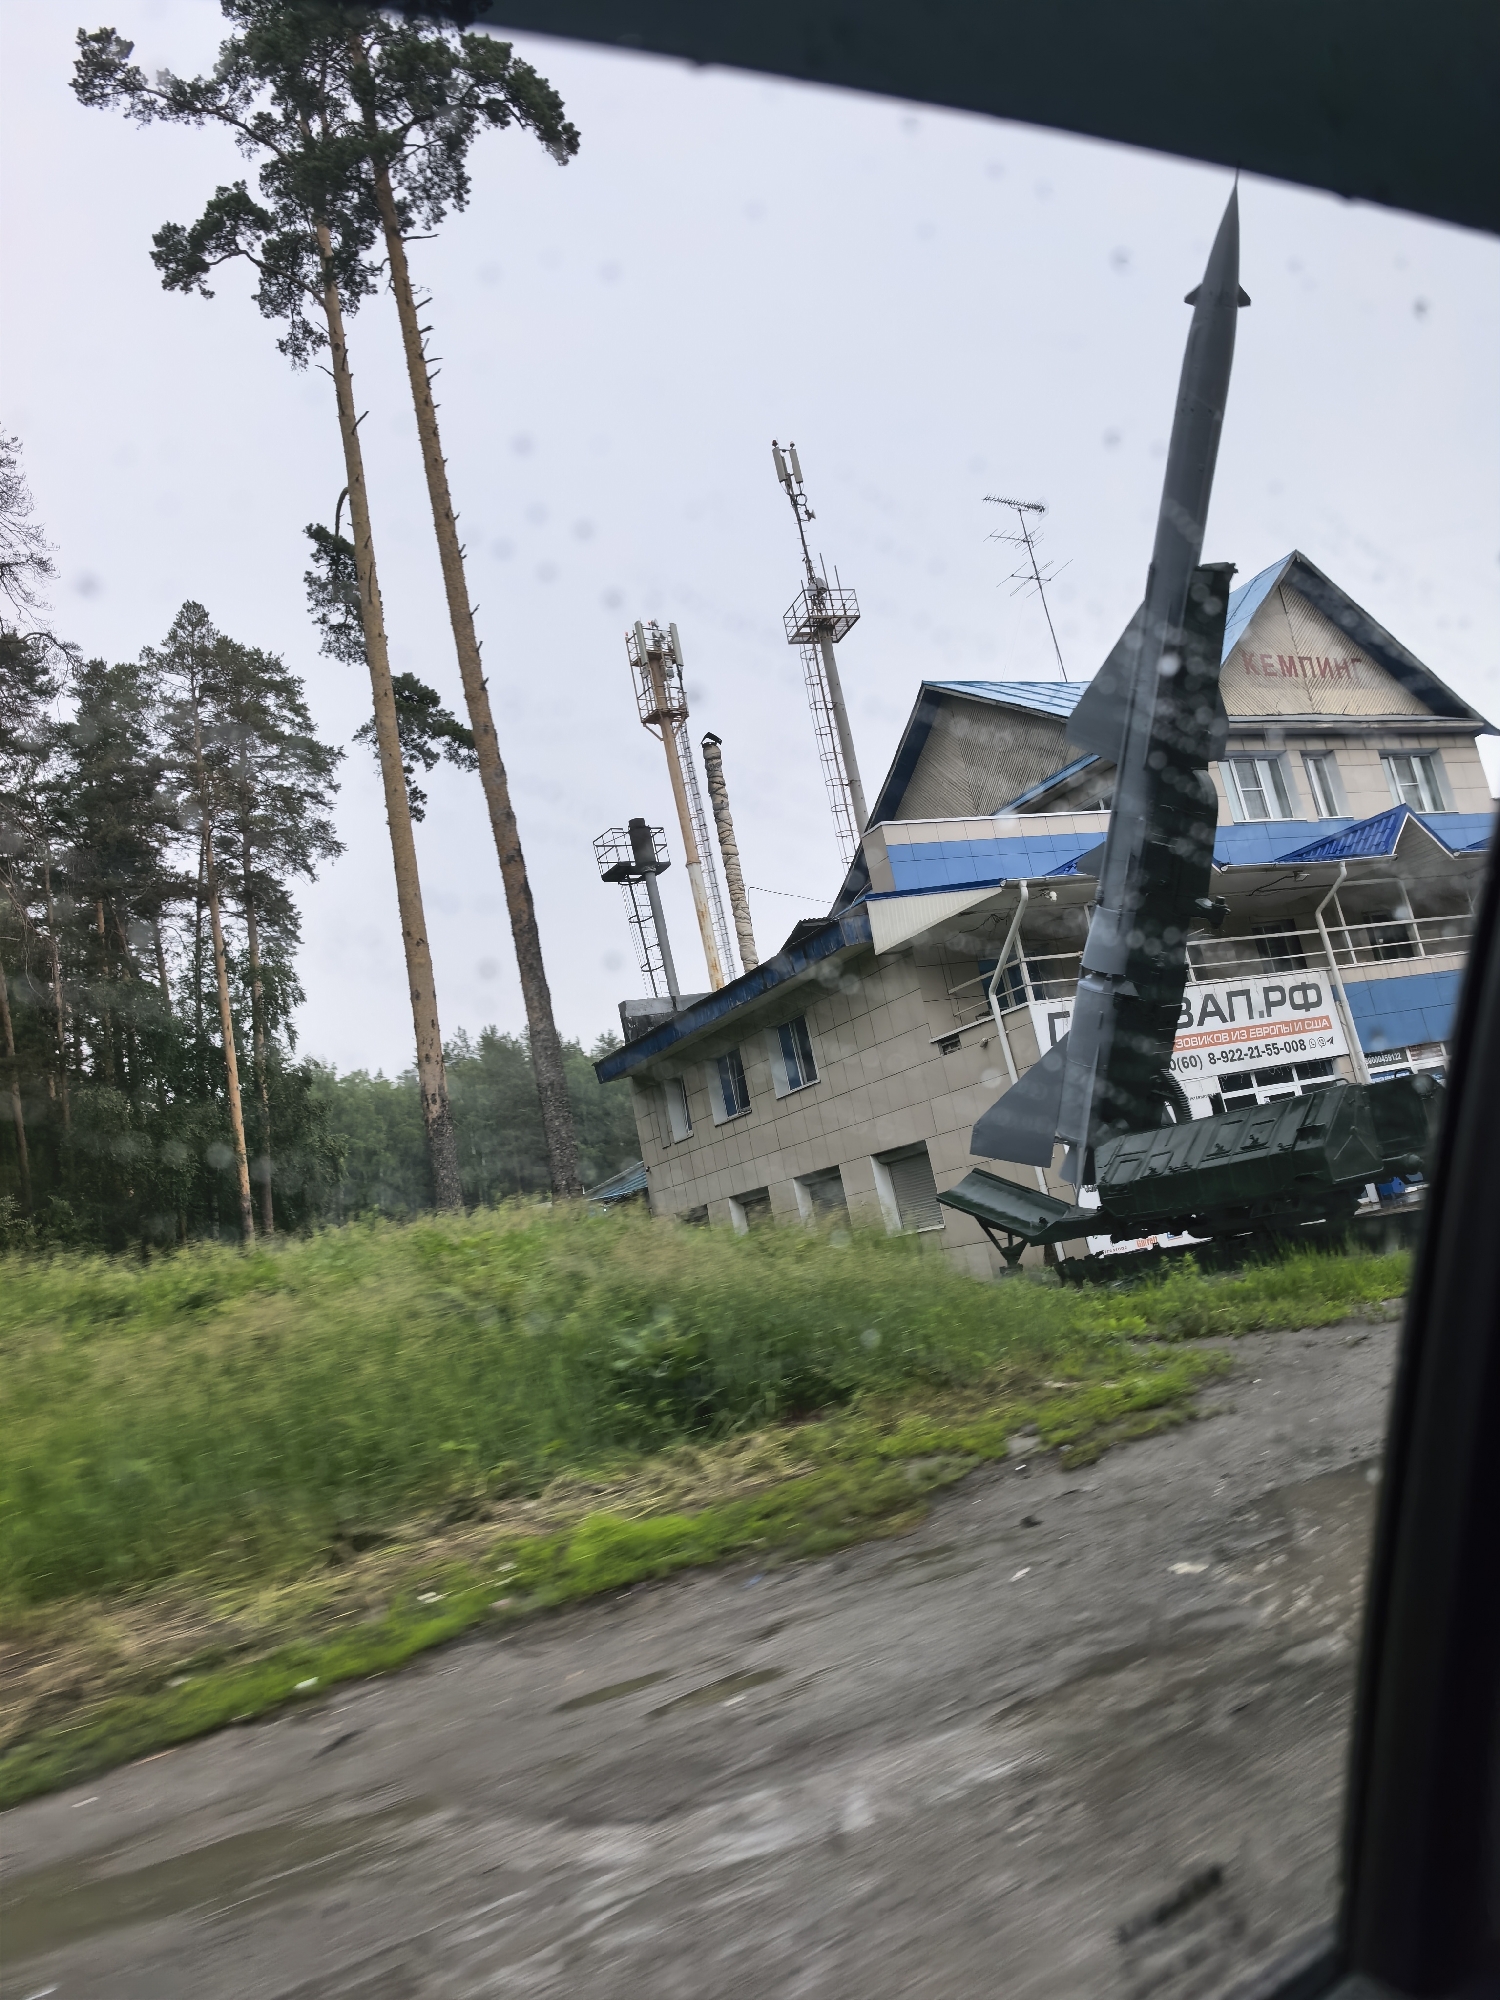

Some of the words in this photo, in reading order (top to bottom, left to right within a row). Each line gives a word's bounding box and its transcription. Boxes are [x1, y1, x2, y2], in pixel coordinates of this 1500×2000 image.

[1239, 649, 1362, 679] КЕМПИНГ
[1231, 1029, 1247, 1040] ИЗ
[1249, 1023, 1293, 1038] ЕВРОПЫ
[1294, 1021, 1303, 1031] И
[1304, 1018, 1330, 1030] США
[1207, 1039, 1307, 1065] 8-922-21-55-008
